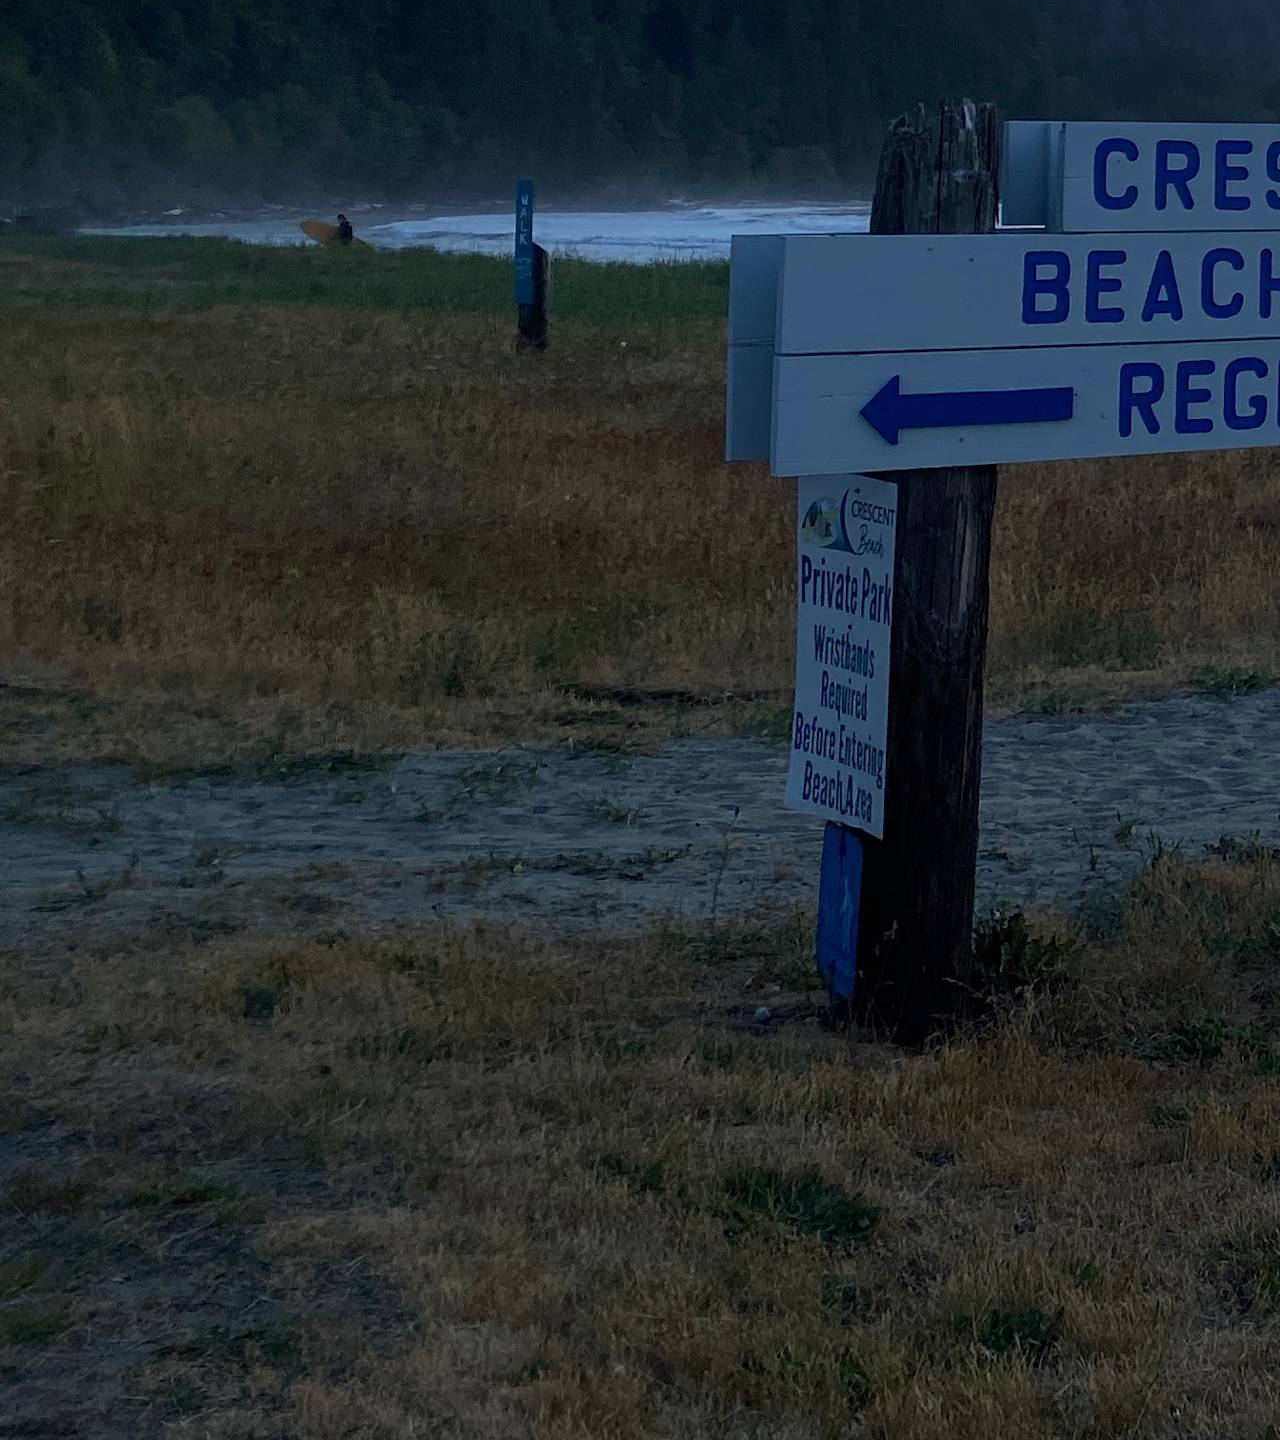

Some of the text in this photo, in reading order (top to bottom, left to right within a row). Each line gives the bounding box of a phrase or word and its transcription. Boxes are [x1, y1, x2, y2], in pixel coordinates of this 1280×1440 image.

[519, 194, 529, 246] WALK
[851, 499, 896, 528] CRESCENT
[801, 554, 892, 626] Private Park
[814, 624, 875, 680] Wristbands
[820, 670, 868, 722] Required
[794, 711, 884, 790] Before Entering
[802, 760, 842, 810] Beach
